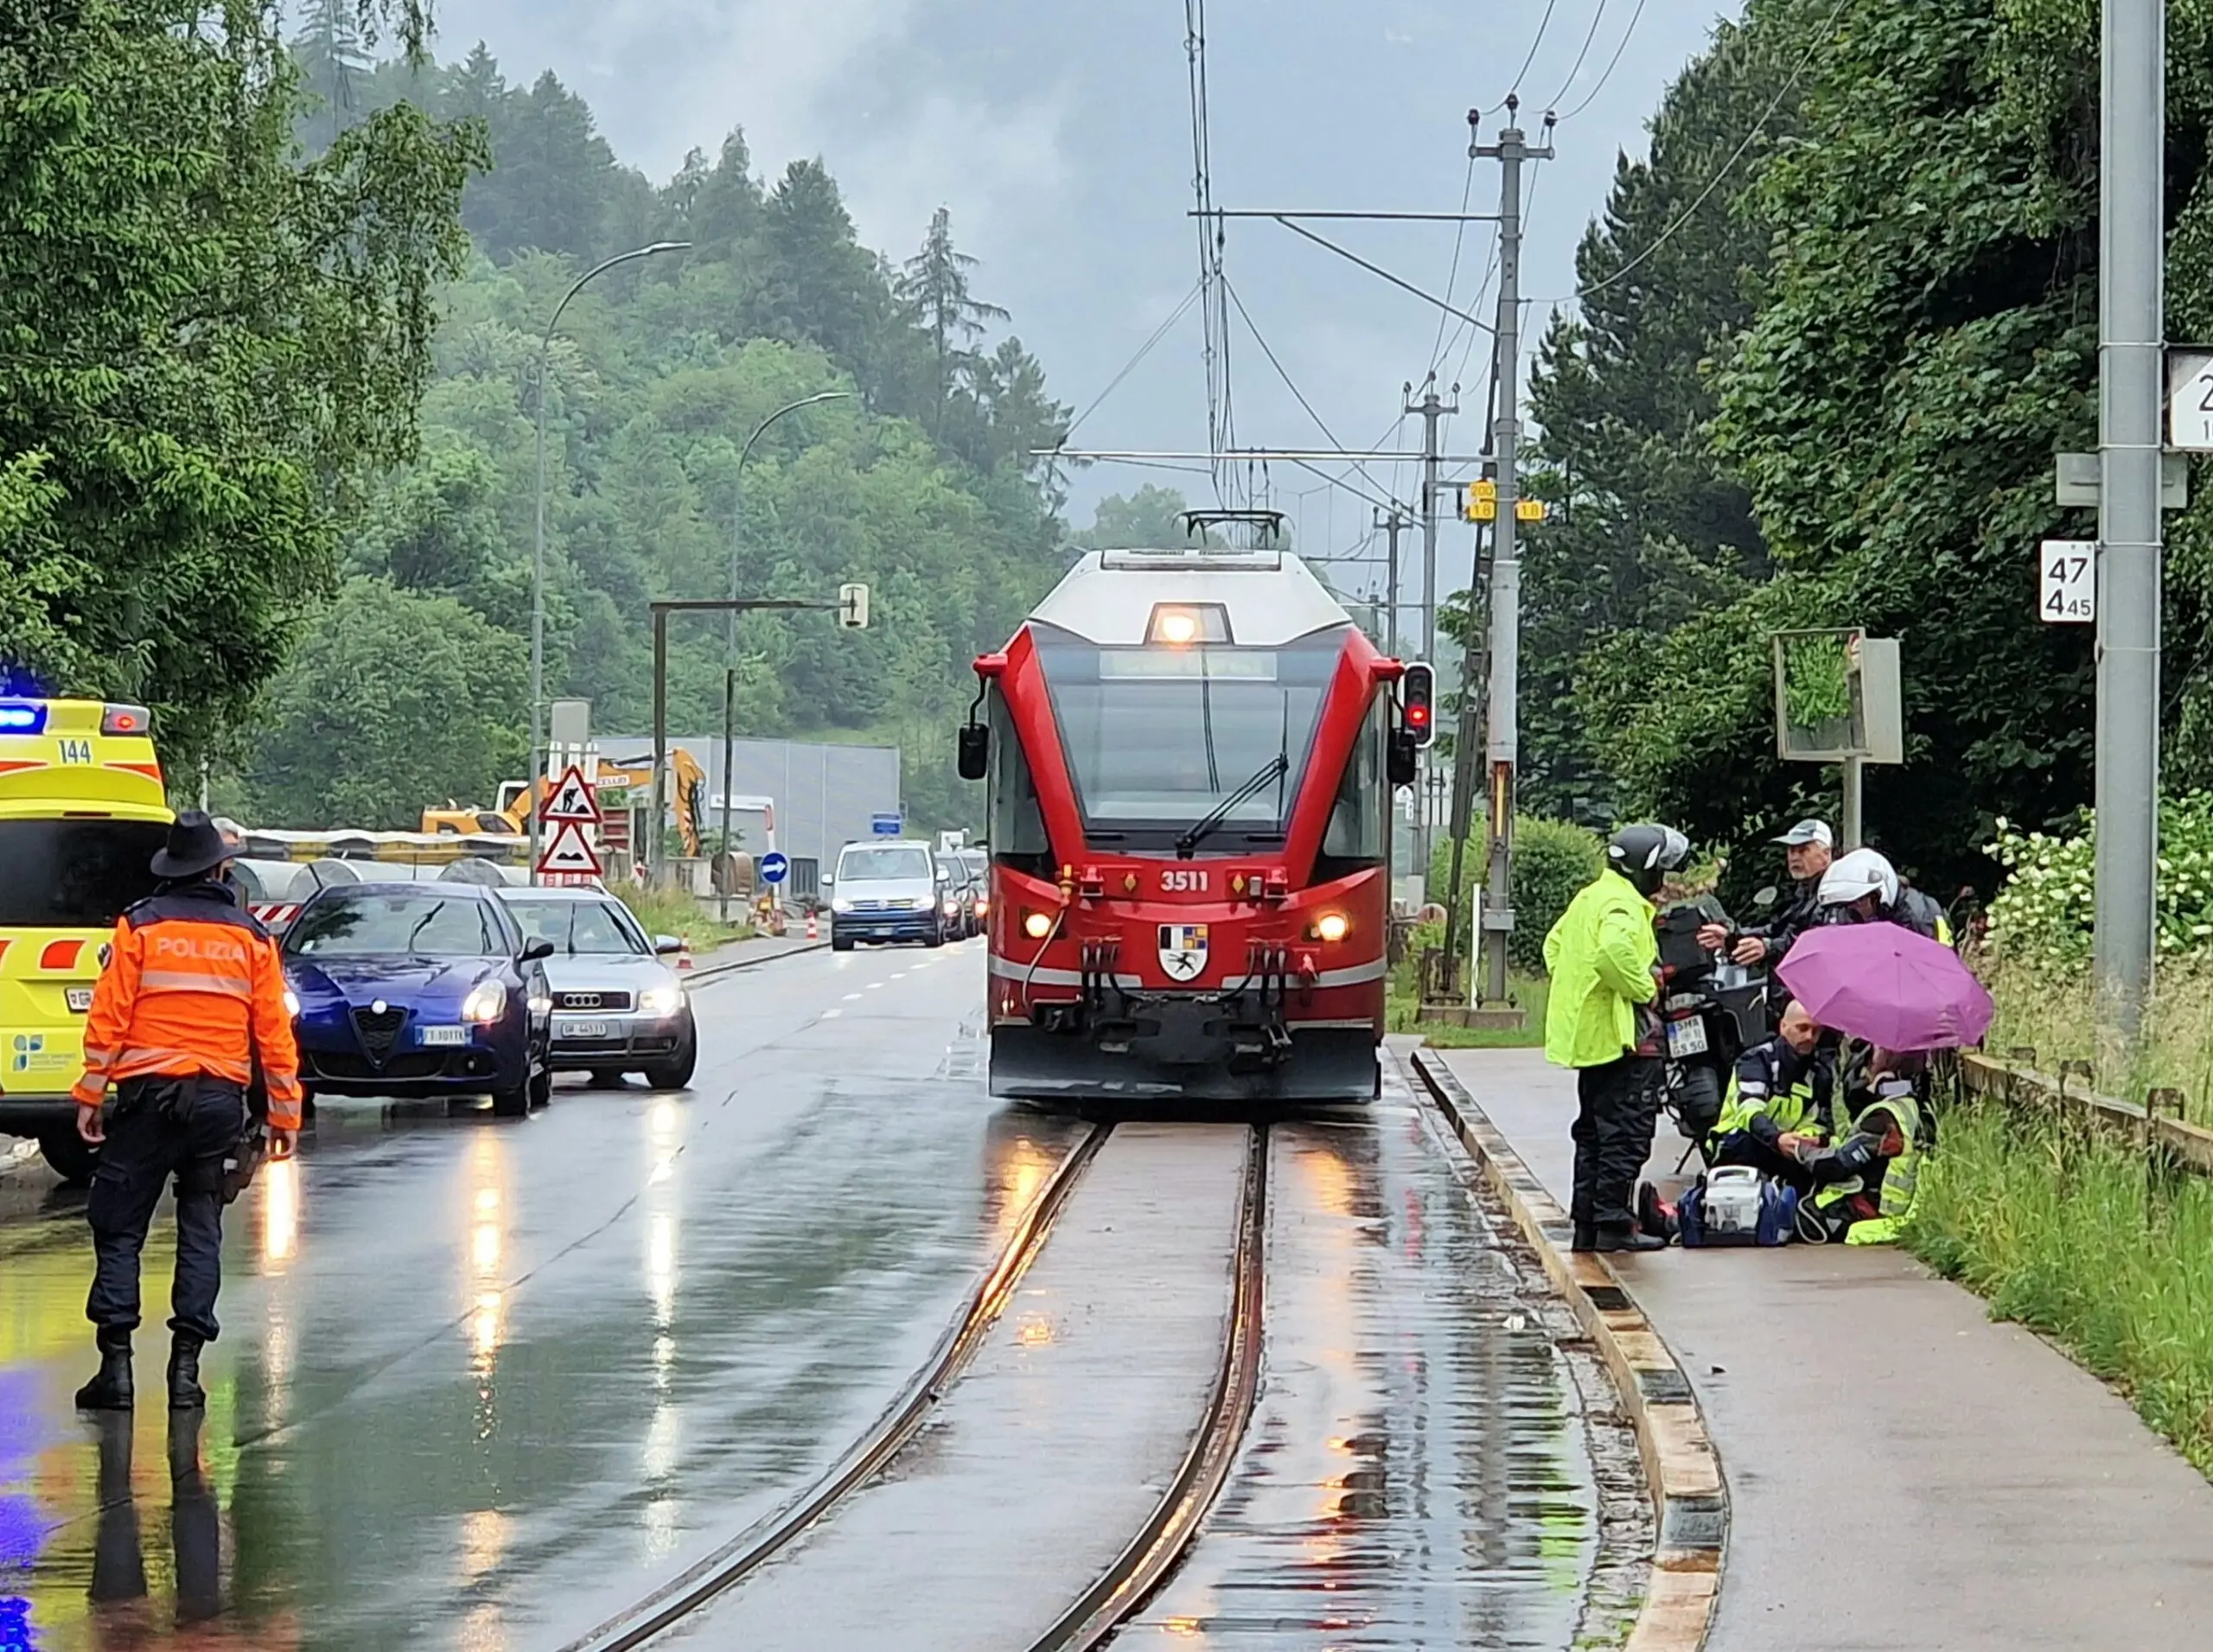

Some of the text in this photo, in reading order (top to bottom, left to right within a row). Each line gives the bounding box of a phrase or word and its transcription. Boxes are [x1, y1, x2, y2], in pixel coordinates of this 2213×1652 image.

[2203, 419, 2213, 441] 1
[2048, 557, 2089, 584] 47
[58, 739, 92, 764] 144
[1160, 871, 1208, 891] 3511
[156, 936, 247, 962] POLIZIA
